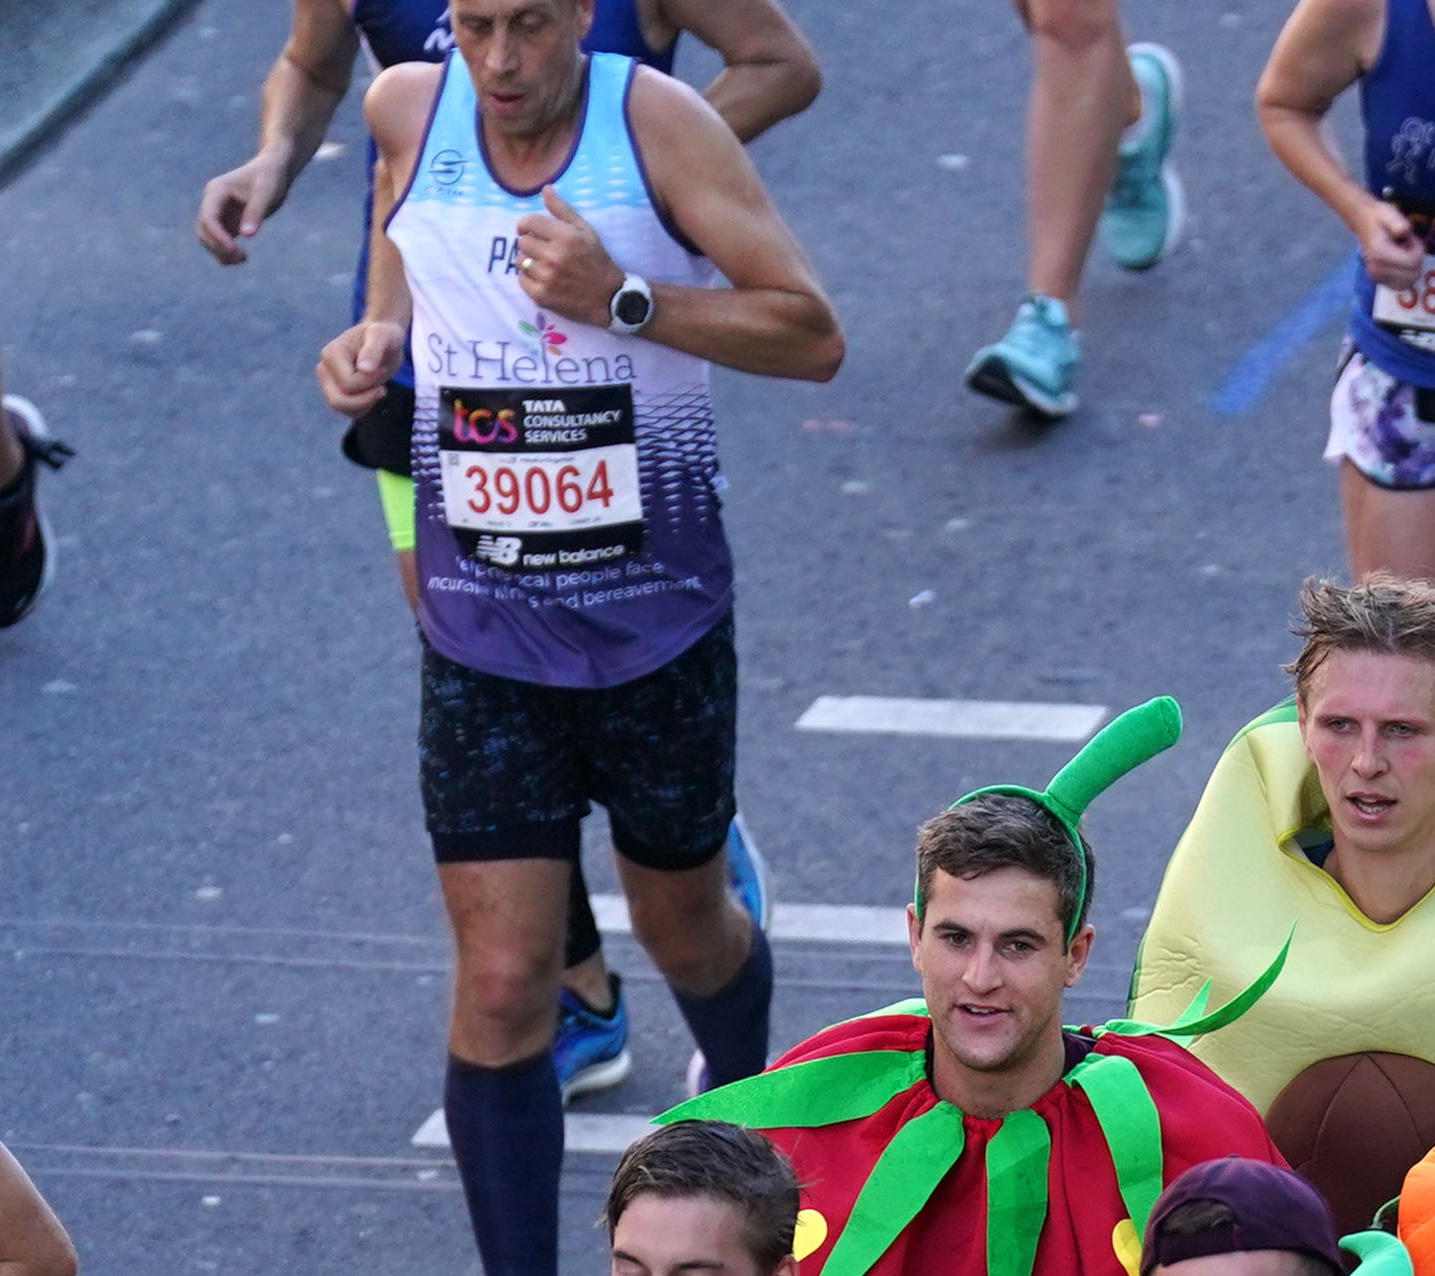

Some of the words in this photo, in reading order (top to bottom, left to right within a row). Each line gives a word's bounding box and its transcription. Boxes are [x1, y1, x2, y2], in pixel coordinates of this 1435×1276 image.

[427, 333, 458, 377] St
[468, 339, 638, 385] Helena
[522, 399, 566, 413] TATA
[453, 398, 518, 443] tcs
[523, 409, 622, 429] CONSULTANCY
[524, 428, 588, 444] SERVICES
[465, 459, 614, 515] 39064
[522, 552, 556, 567] new
[558, 544, 626, 564] balance
[555, 567, 620, 592] people
